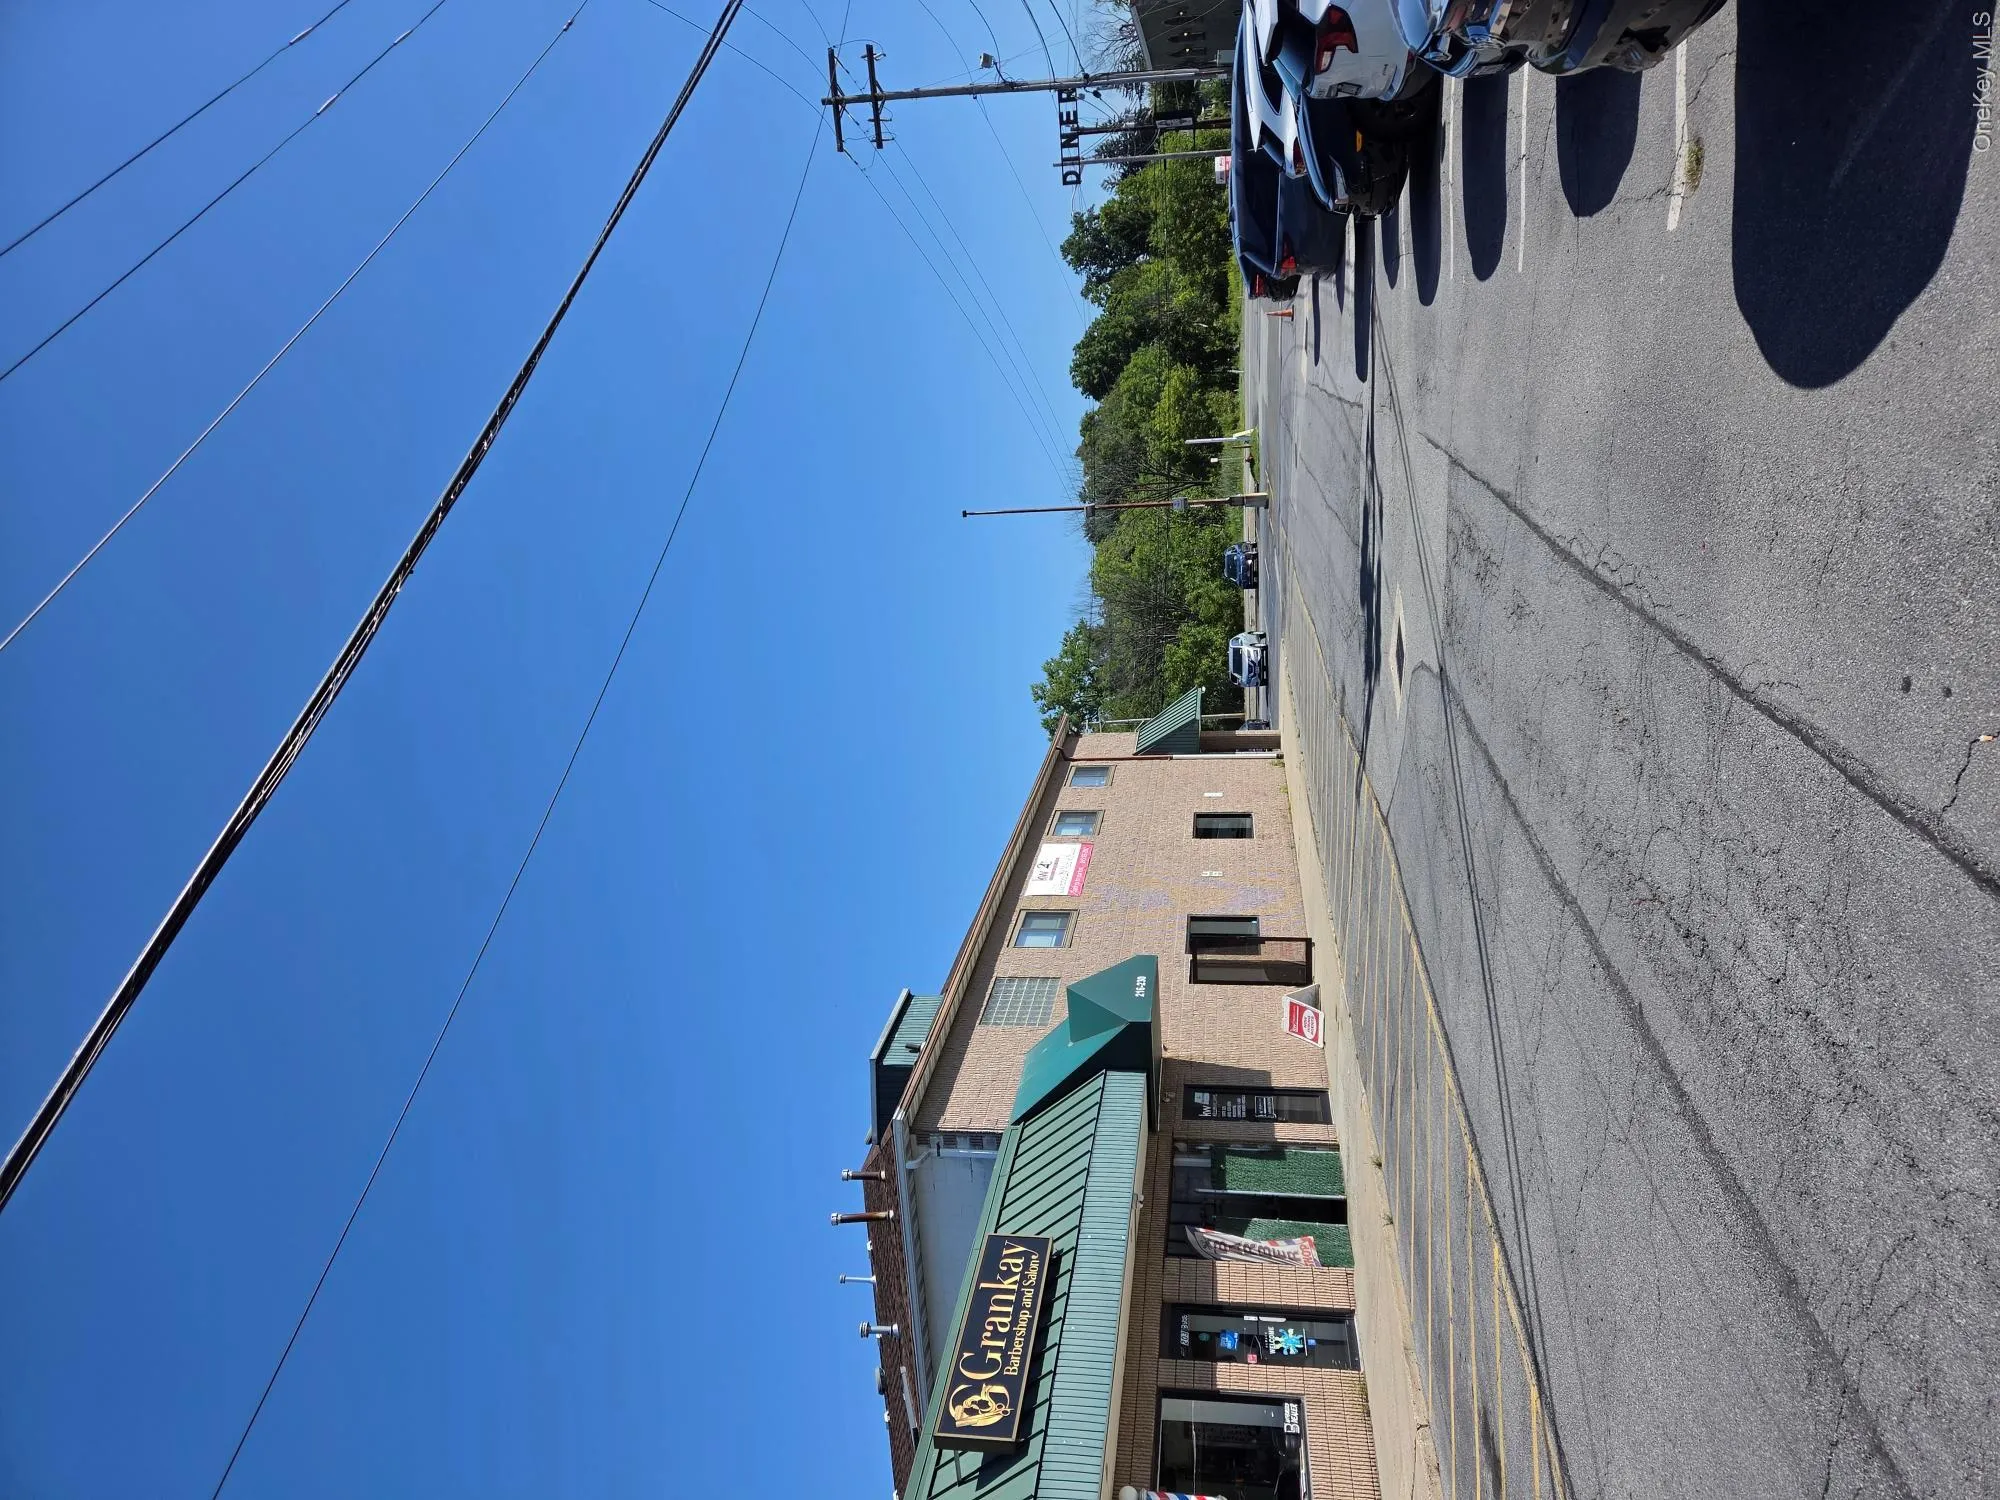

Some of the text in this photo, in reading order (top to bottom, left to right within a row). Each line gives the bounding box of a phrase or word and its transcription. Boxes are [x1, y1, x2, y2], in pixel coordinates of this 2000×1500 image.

[1057, 88, 1081, 185] DINER
[1135, 976, 1146, 997] 216-230
[1198, 1104, 1211, 1116] kw
[1214, 1241, 1299, 1258] BARBER
[959, 1240, 1039, 1380] Grankay
[1003, 1260, 1040, 1376] Barbershop and Salon
[1268, 1326, 1276, 1354] WELCOME
